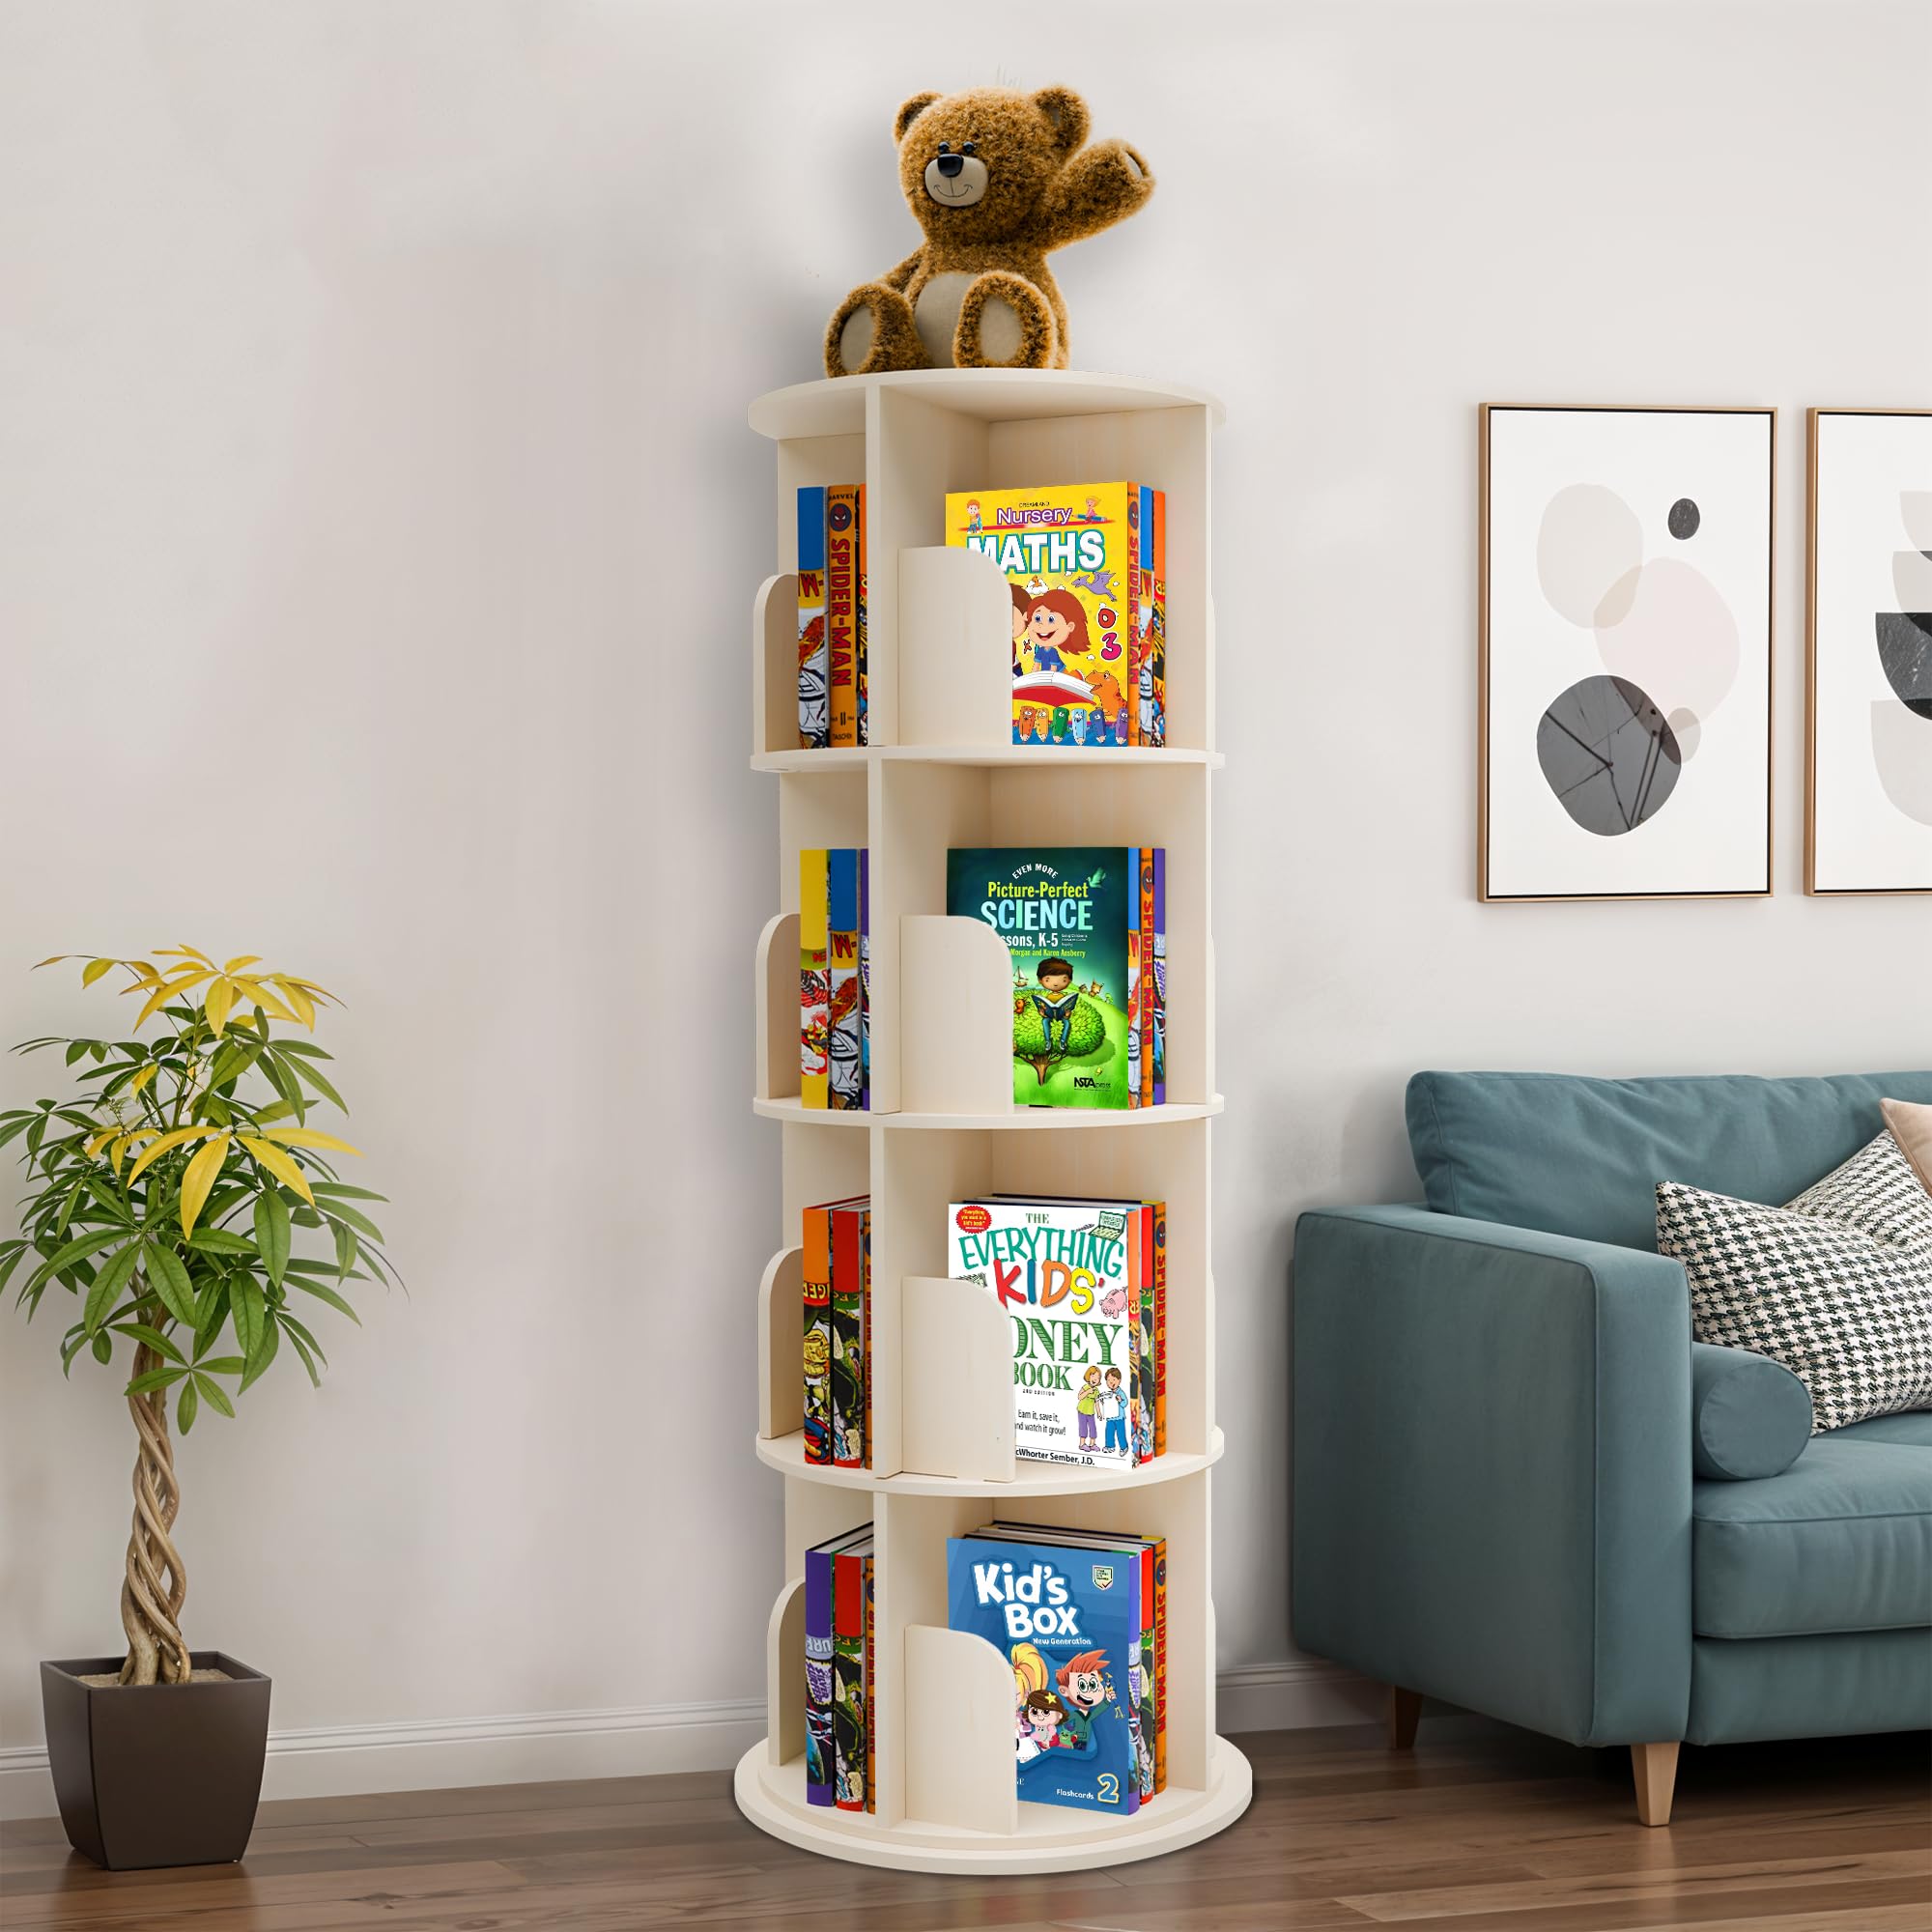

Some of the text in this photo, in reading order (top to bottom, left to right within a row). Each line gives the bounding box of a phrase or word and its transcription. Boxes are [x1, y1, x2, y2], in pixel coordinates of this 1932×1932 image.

[997, 508, 1072, 526] Nursery
[831, 537, 851, 687] SPIDER-MAN
[1128, 535, 1139, 685] SPIDER-MAN
[1100, 633, 1122, 661] 3
[1011, 863, 1059, 879] EVEN MORE
[987, 881, 1089, 897] Picture-Perfect
[980, 898, 1094, 930] SCIENCE
[1038, 932, 1058, 947] K-5
[1142, 900, 1153, 1045] SPIDER-MAN
[1025, 1212, 1050, 1224] THE
[958, 1226, 1126, 1278] EVERYTHING
[1155, 1254, 1167, 1399] SPIDER-MAN
[1024, 1423, 1042, 1433] watch
[1043, 1424, 1048, 1433] it
[1049, 1426, 1066, 1436] grow!
[1049, 1452, 1080, 1464] Sember,
[1080, 1456, 1095, 1465] J.D.
[973, 1562, 1069, 1605] Kid's
[1004, 1602, 1080, 1638] Box
[1033, 1637, 1092, 1646] New Generation
[1156, 1592, 1167, 1736] SPIDER-MAN
[1056, 1773, 1120, 1804] Flashcards 2
